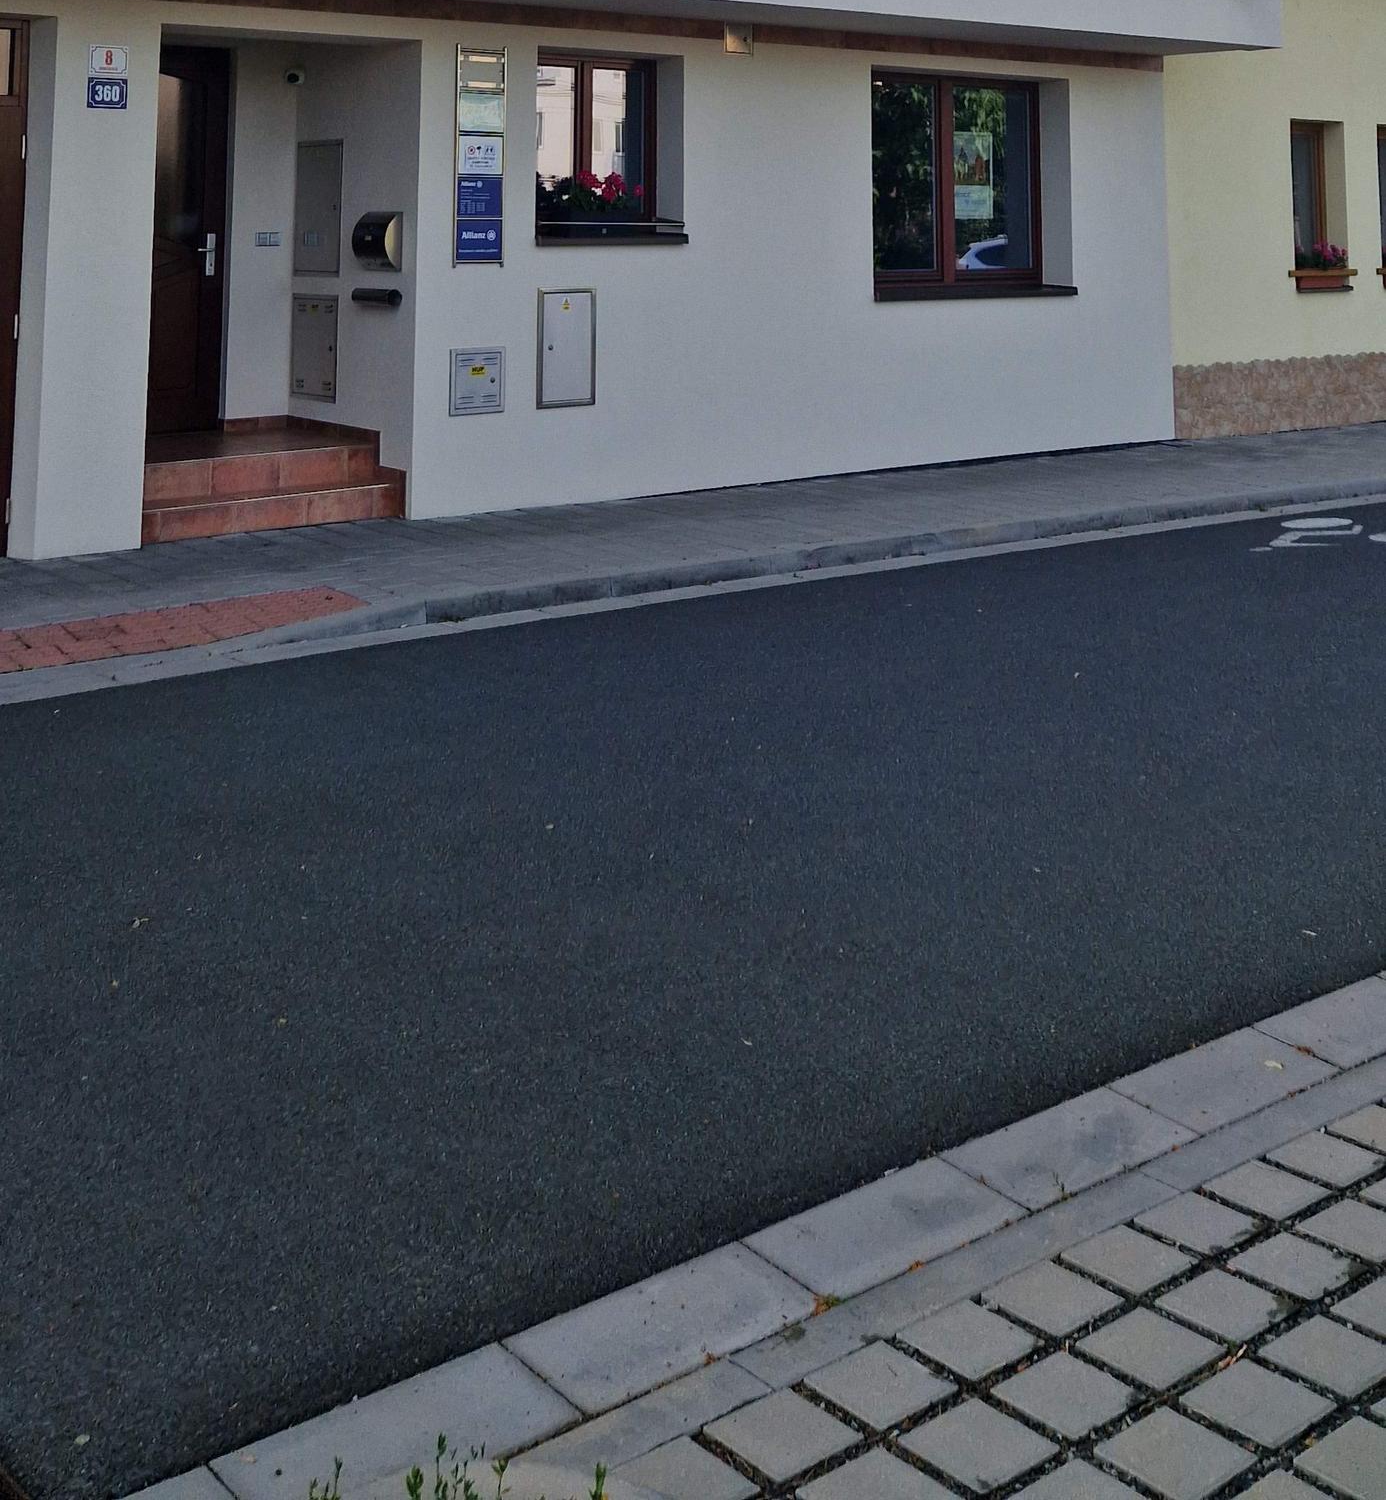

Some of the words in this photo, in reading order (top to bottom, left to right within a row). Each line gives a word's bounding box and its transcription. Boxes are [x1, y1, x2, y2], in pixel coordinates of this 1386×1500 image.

[105, 50, 113, 65] 8
[94, 84, 120, 102] 360
[461, 231, 486, 240] Allianz
